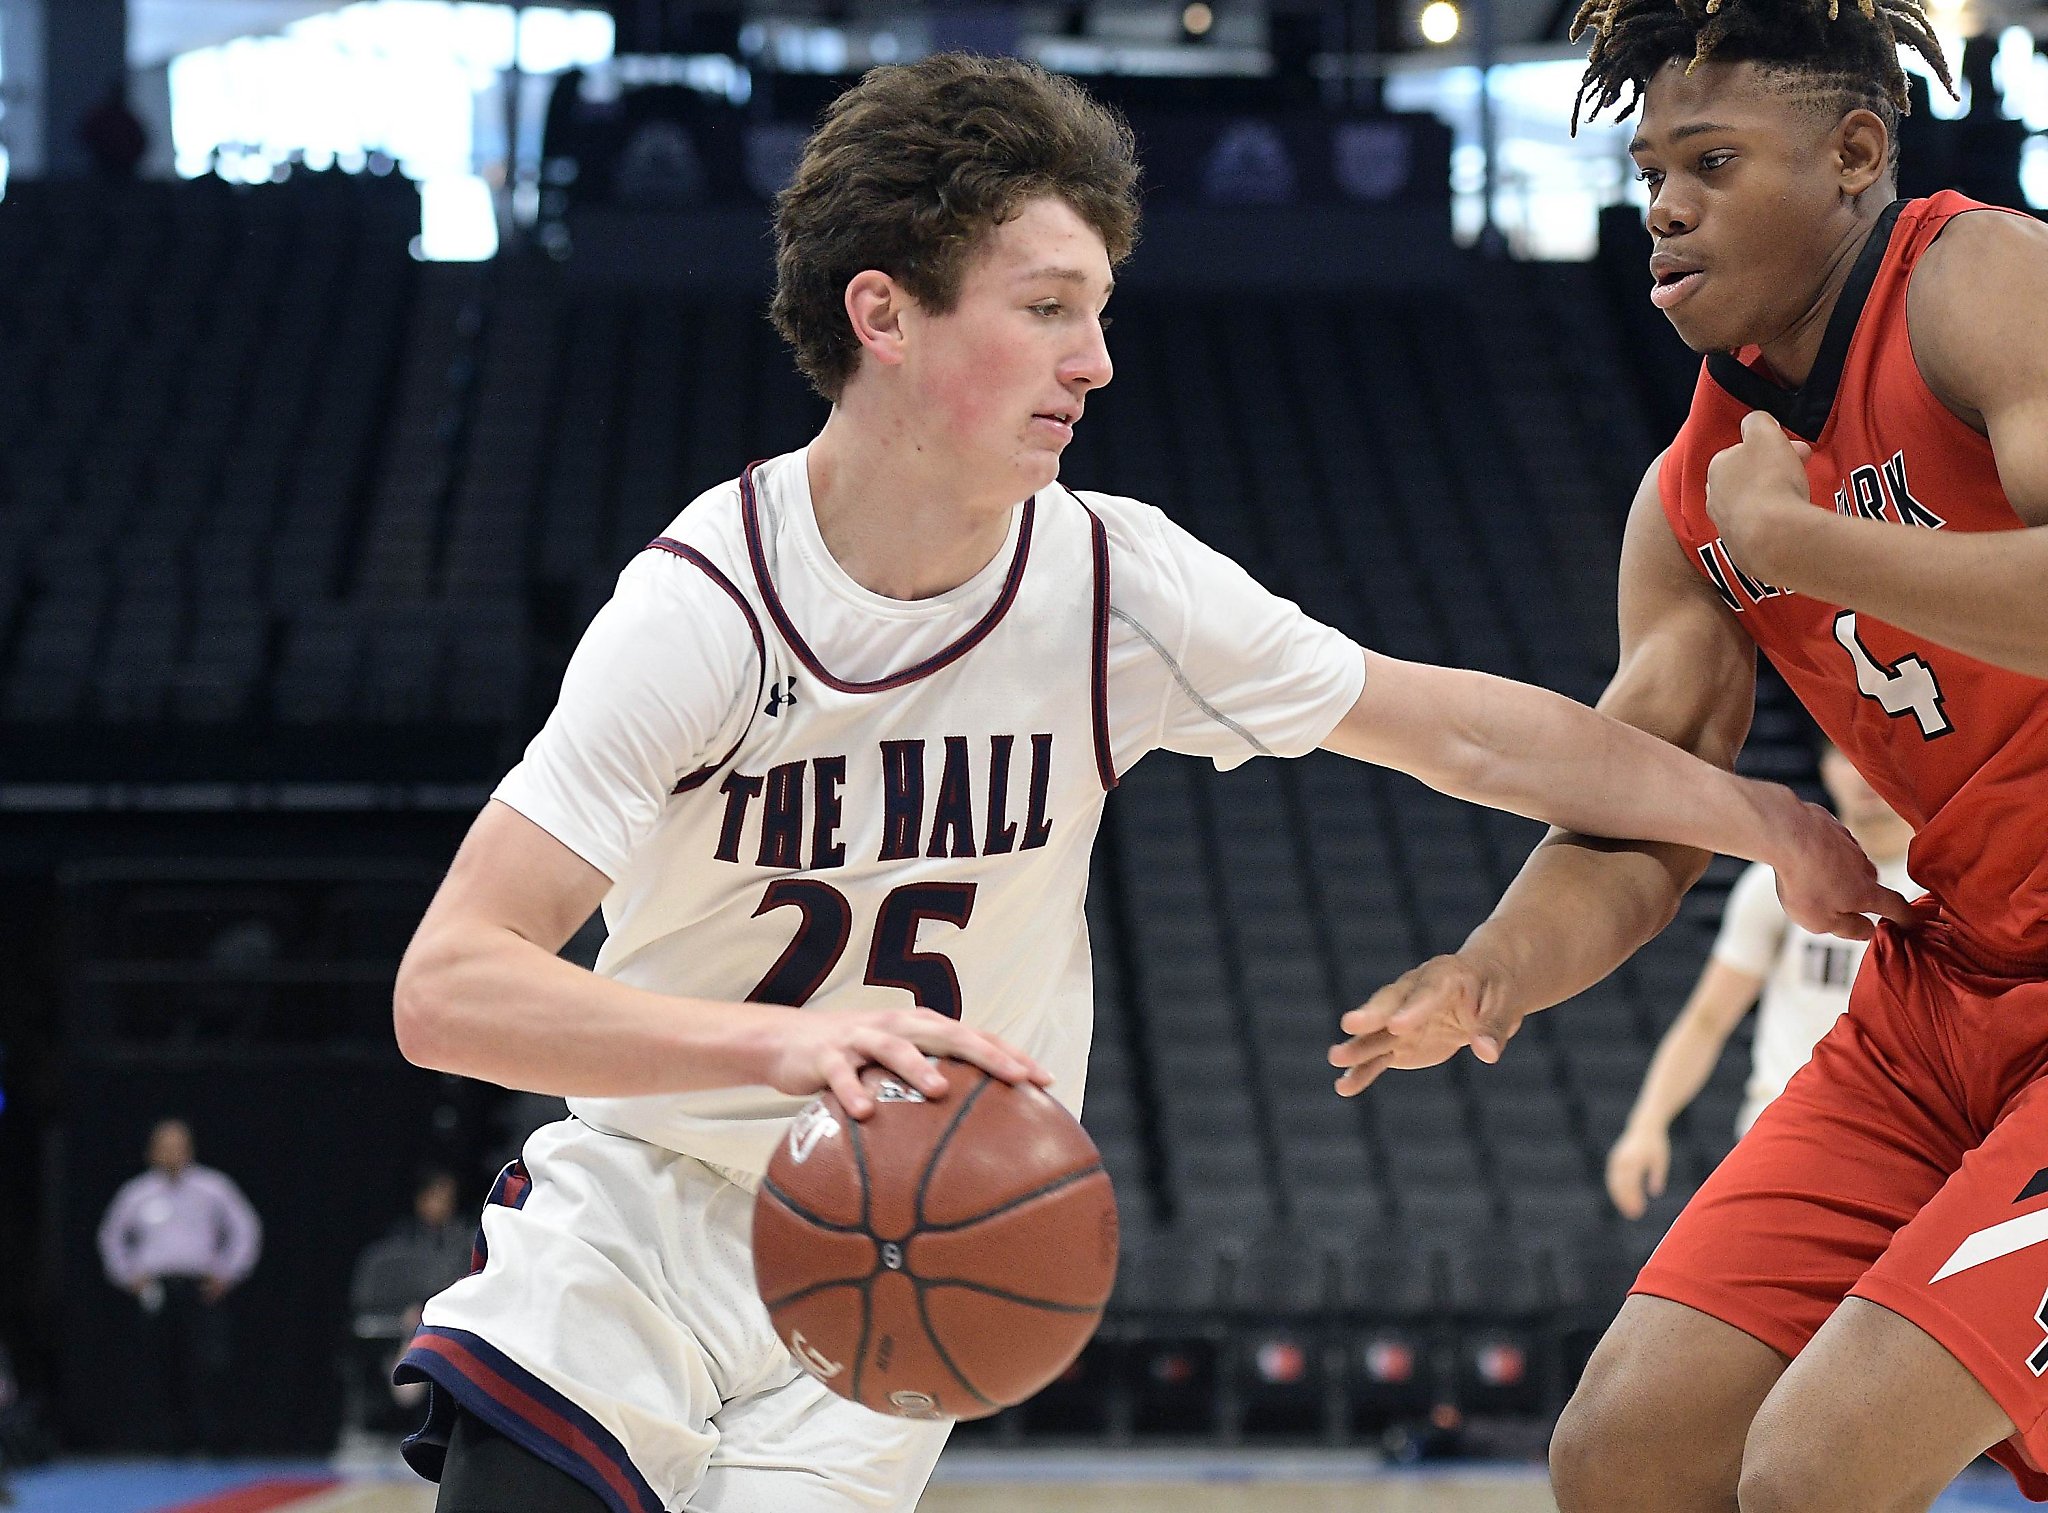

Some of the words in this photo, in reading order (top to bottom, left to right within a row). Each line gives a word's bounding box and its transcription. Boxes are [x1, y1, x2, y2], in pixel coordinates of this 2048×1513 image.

[1832, 608, 1955, 742] 4
[714, 755, 846, 870] THE
[877, 733, 1054, 862] HALL
[743, 878, 979, 1022] 25
